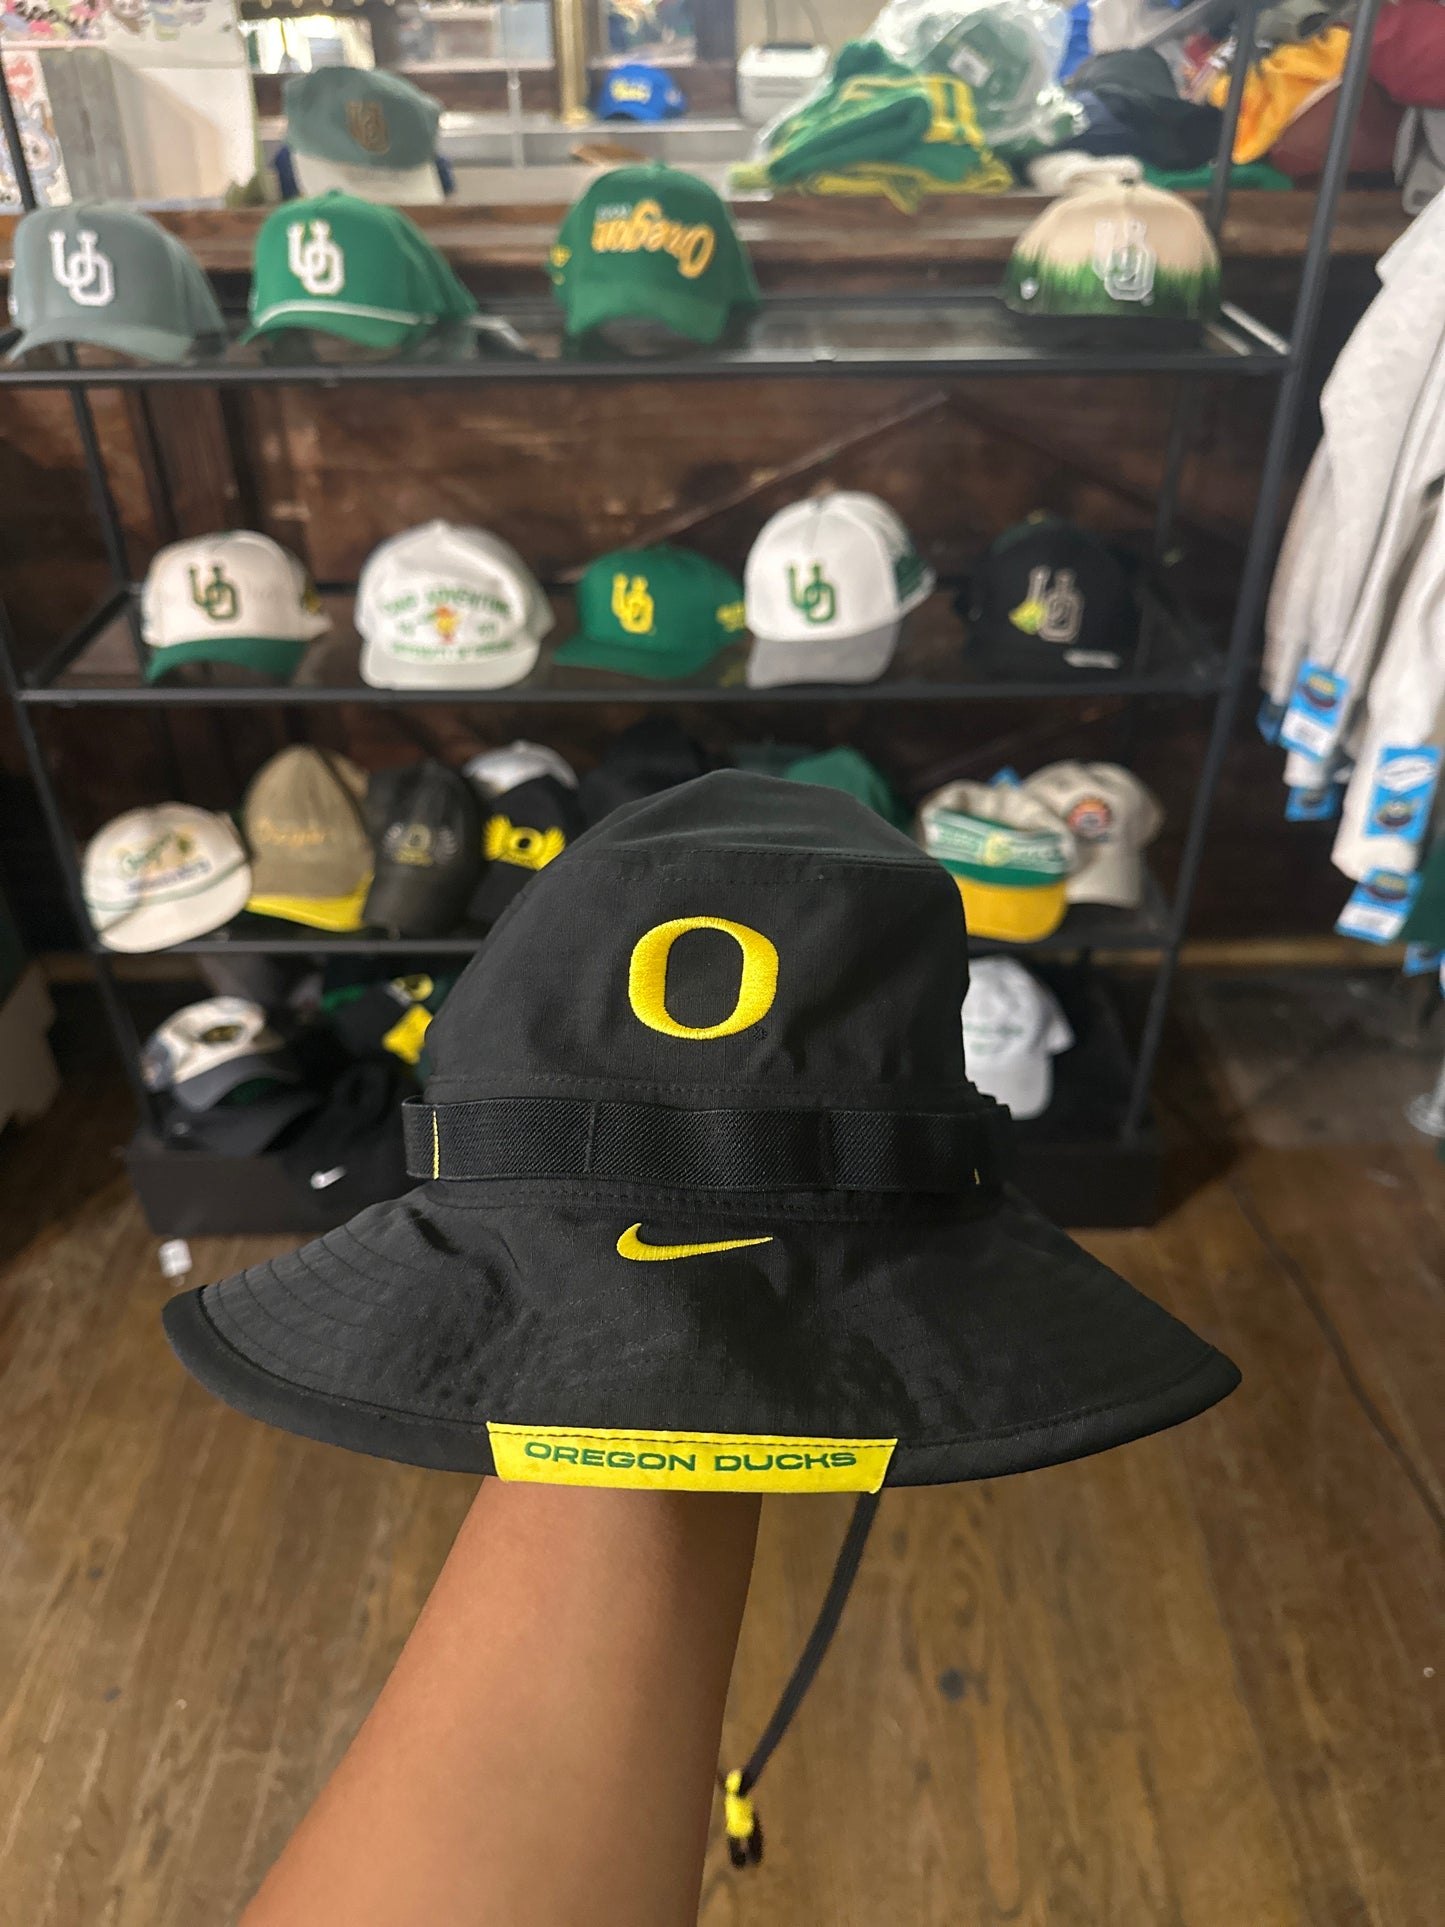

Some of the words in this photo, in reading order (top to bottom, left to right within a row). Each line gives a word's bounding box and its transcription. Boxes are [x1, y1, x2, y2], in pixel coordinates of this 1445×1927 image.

[49, 229, 115, 306] UO
[288, 219, 345, 296] UO
[628, 915, 779, 1041] O
[524, 1441, 697, 1472] OREGON
[715, 1451, 857, 1472] DUCKS
